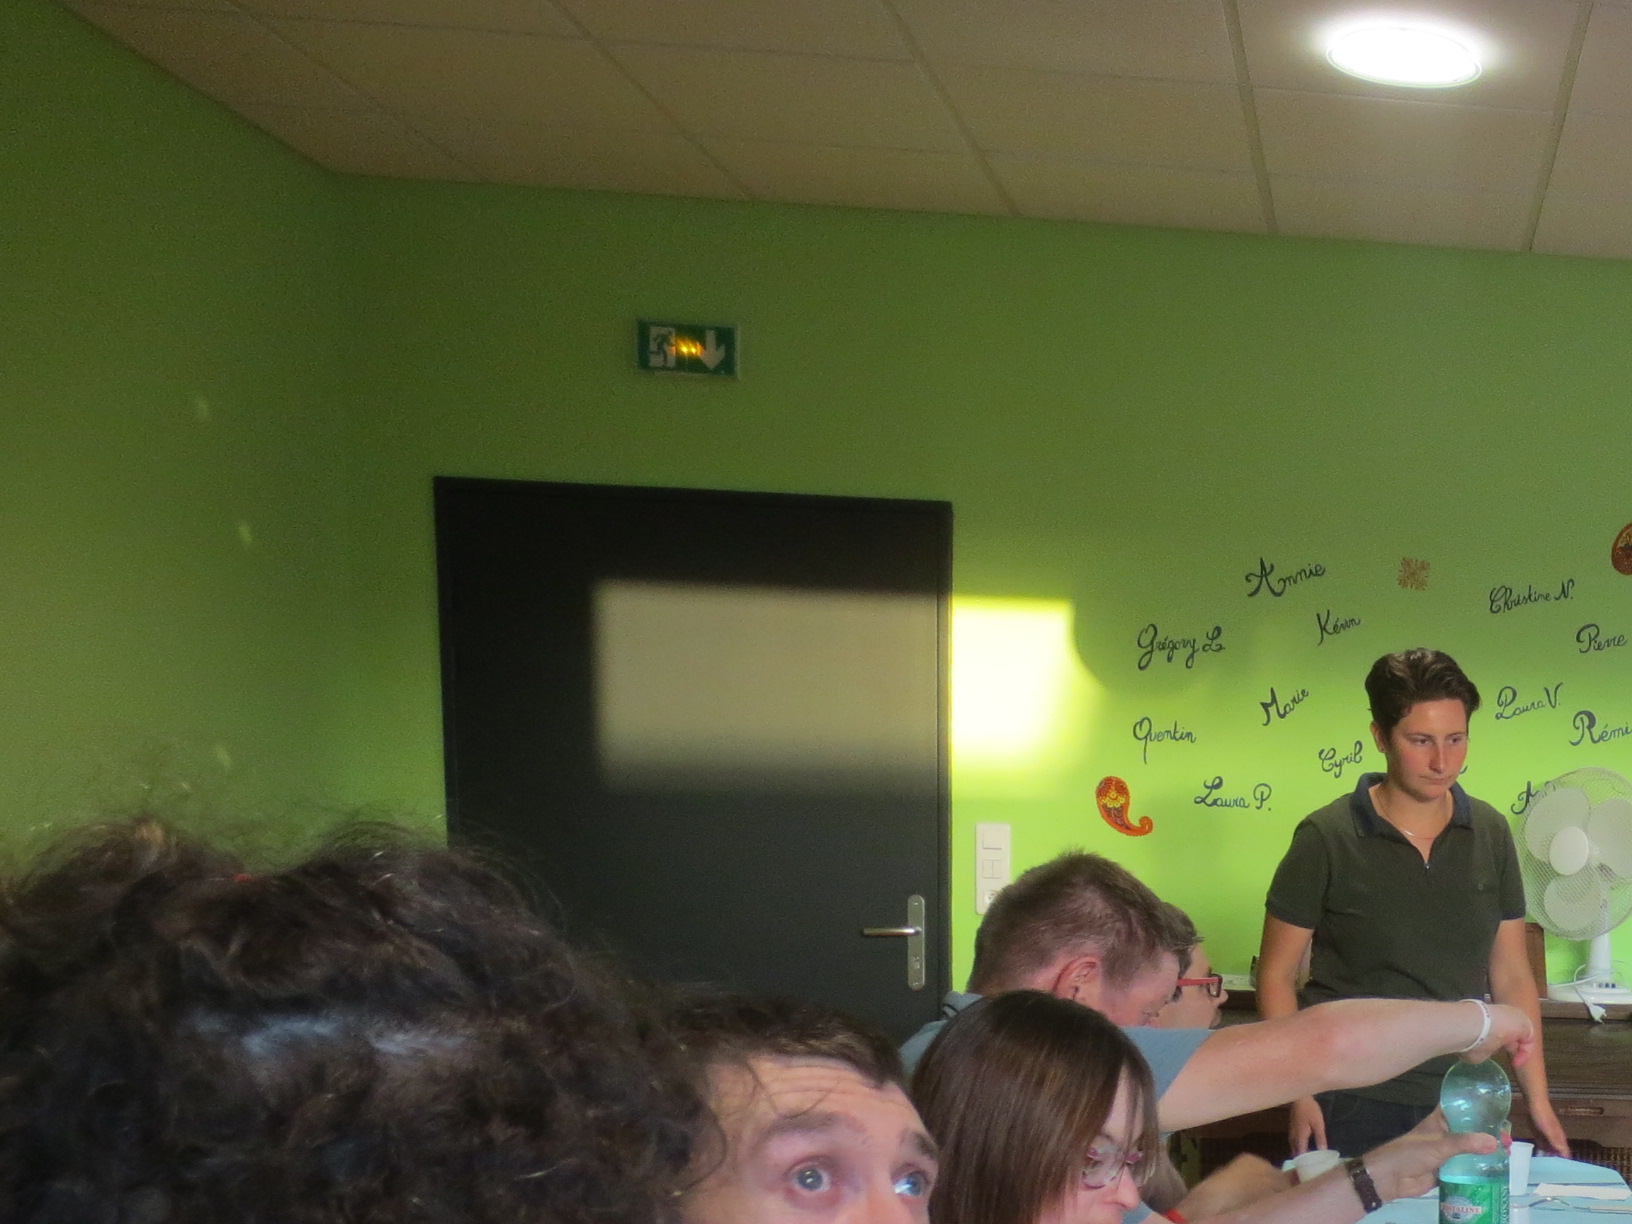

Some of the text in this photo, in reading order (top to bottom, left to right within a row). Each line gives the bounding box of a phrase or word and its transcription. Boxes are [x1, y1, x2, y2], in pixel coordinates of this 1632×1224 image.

[1245, 557, 1326, 597] Annie
[1489, 584, 1551, 614] Christine
[1316, 609, 1361, 646] Kévin
[1576, 623, 1628, 653] Pierre
[1137, 623, 1200, 670] Grégory
[1260, 687, 1309, 726] Marie
[1133, 717, 1196, 764] Quentin
[1569, 710, 1632, 746] Rémi
[1318, 740, 1363, 778] Cyril
[1194, 776, 1249, 808] Laura
